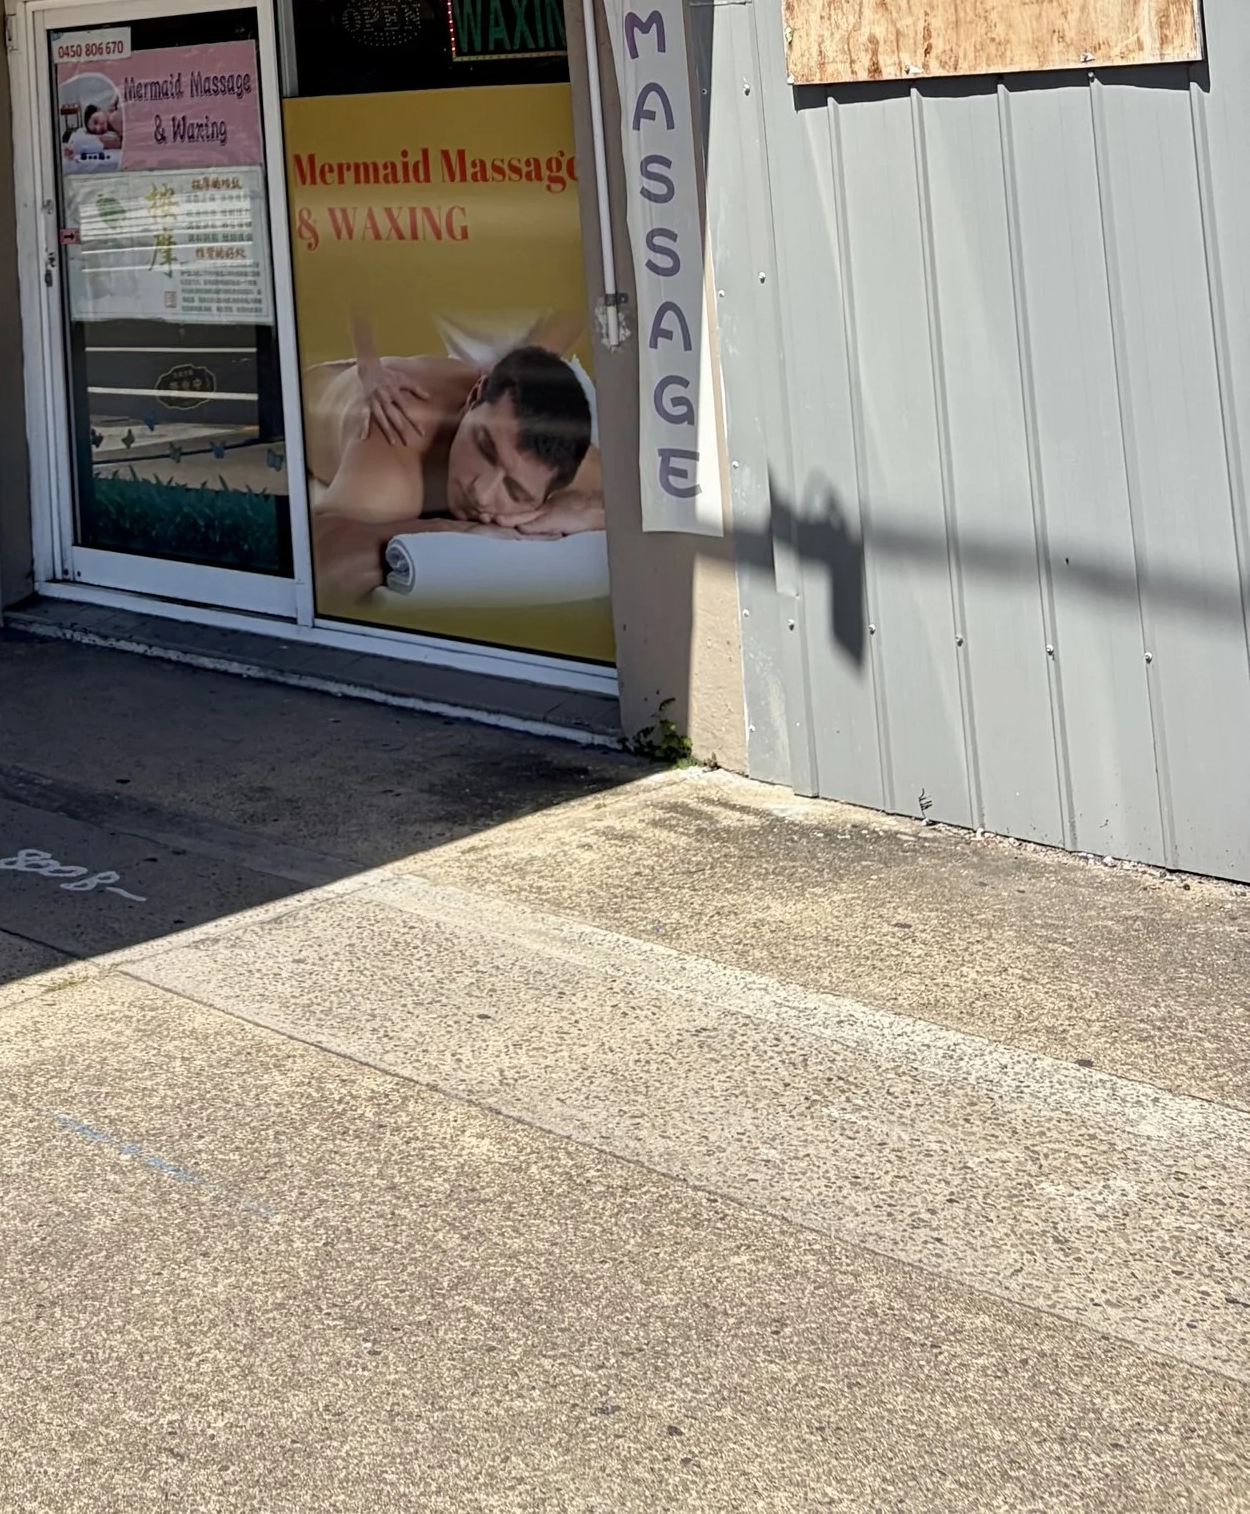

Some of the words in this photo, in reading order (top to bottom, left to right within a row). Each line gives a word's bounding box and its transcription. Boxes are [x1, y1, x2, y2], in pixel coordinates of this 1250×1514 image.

[57, 44, 83, 59] 0450
[85, 42, 104, 57] 806
[105, 40, 124, 55] 670
[123, 72, 185, 103] Mermaid
[190, 70, 253, 100] Massage
[153, 114, 167, 146] &
[171, 115, 228, 147] Waxing
[292, 148, 432, 186] Mermaid
[295, 207, 320, 252] &
[327, 206, 470, 243] WAXING
[623, 8, 703, 500] MASSAGE
